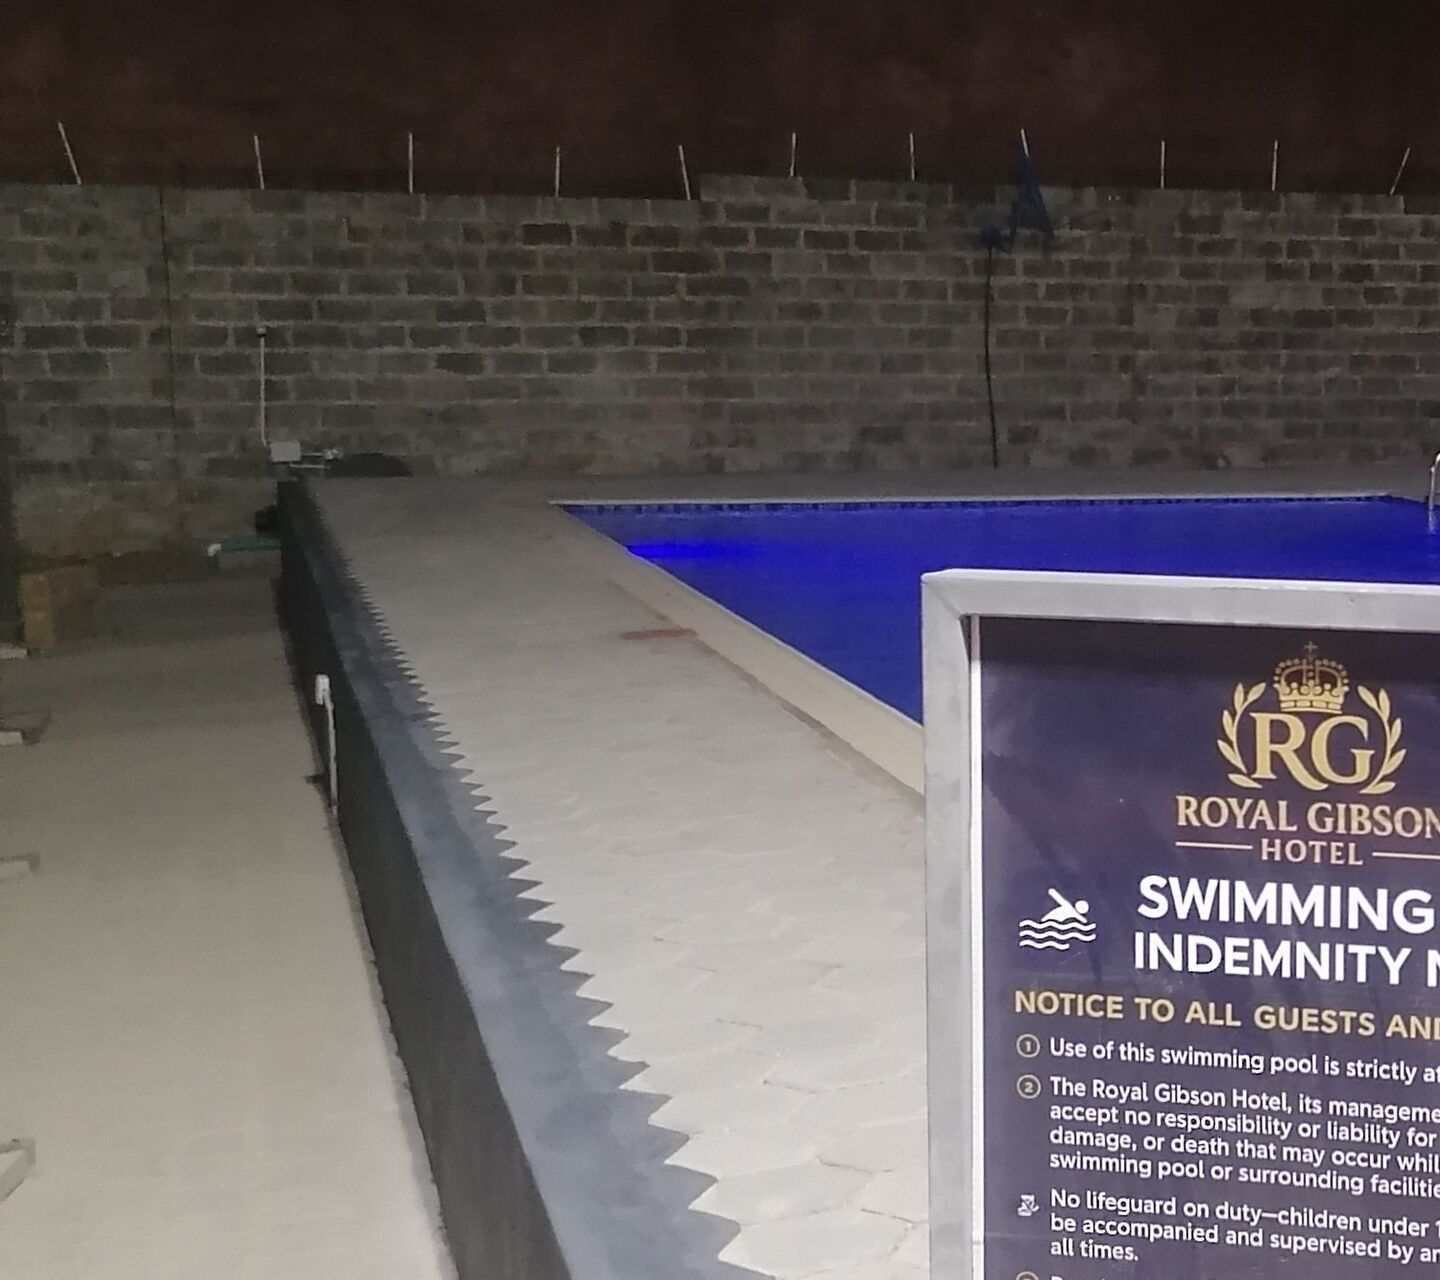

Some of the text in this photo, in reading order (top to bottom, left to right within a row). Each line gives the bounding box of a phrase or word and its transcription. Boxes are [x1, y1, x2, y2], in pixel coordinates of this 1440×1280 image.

[1249, 711, 1376, 791] RG
[1175, 794, 1298, 832] ROYAL
[1260, 837, 1364, 866] HOTEL
[1136, 874, 1436, 935] SWIMMING
[1134, 931, 1413, 986] INDEMNITY
[1014, 989, 1124, 1020] NOTICE
[1133, 997, 1175, 1023] TO
[1184, 1000, 1243, 1027] ALL
[1253, 1004, 1376, 1037] GUESTS
[1049, 1036, 1088, 1059] Use
[1091, 1039, 1115, 1061] of
[1118, 1040, 1156, 1063] this
[1160, 1045, 1265, 1074] swimming
[1269, 1053, 1319, 1076] pool
[1324, 1054, 1341, 1077] is
[1345, 1057, 1418, 1086] strictly
[1049, 1075, 1087, 1098] The
[1092, 1078, 1149, 1105] Royal
[1154, 1082, 1226, 1108] Gibson
[1232, 1087, 1293, 1115] Hotel,
[1298, 1092, 1323, 1115] its
[1049, 1104, 1120, 1127] accept
[1124, 1109, 1152, 1126] no
[1156, 1111, 1293, 1141] responsibility
[1297, 1122, 1322, 1139] or
[1326, 1119, 1401, 1150] liability
[1405, 1126, 1438, 1149] for
[1049, 1124, 1138, 1153] damage,
[1142, 1135, 1166, 1152] or
[1170, 1133, 1230, 1157] death
[1235, 1138, 1277, 1161] that
[1281, 1145, 1326, 1169] may
[1330, 1149, 1392, 1170] occur
[1049, 1150, 1152, 1179] swimming
[1157, 1159, 1205, 1181] pool
[1210, 1164, 1234, 1181] or
[1237, 1166, 1365, 1197] surrounding
[1050, 1187, 1081, 1209] No
[1086, 1189, 1177, 1216] lifeguard
[1182, 1201, 1210, 1219] on
[1367, 1215, 1431, 1238] under
[1050, 1211, 1077, 1233] be
[1082, 1218, 1219, 1244] accompanied
[1225, 1227, 1264, 1248] and
[1269, 1233, 1382, 1258] supervised
[1387, 1238, 1415, 1265] by
[1050, 1236, 1140, 1262] all times.
